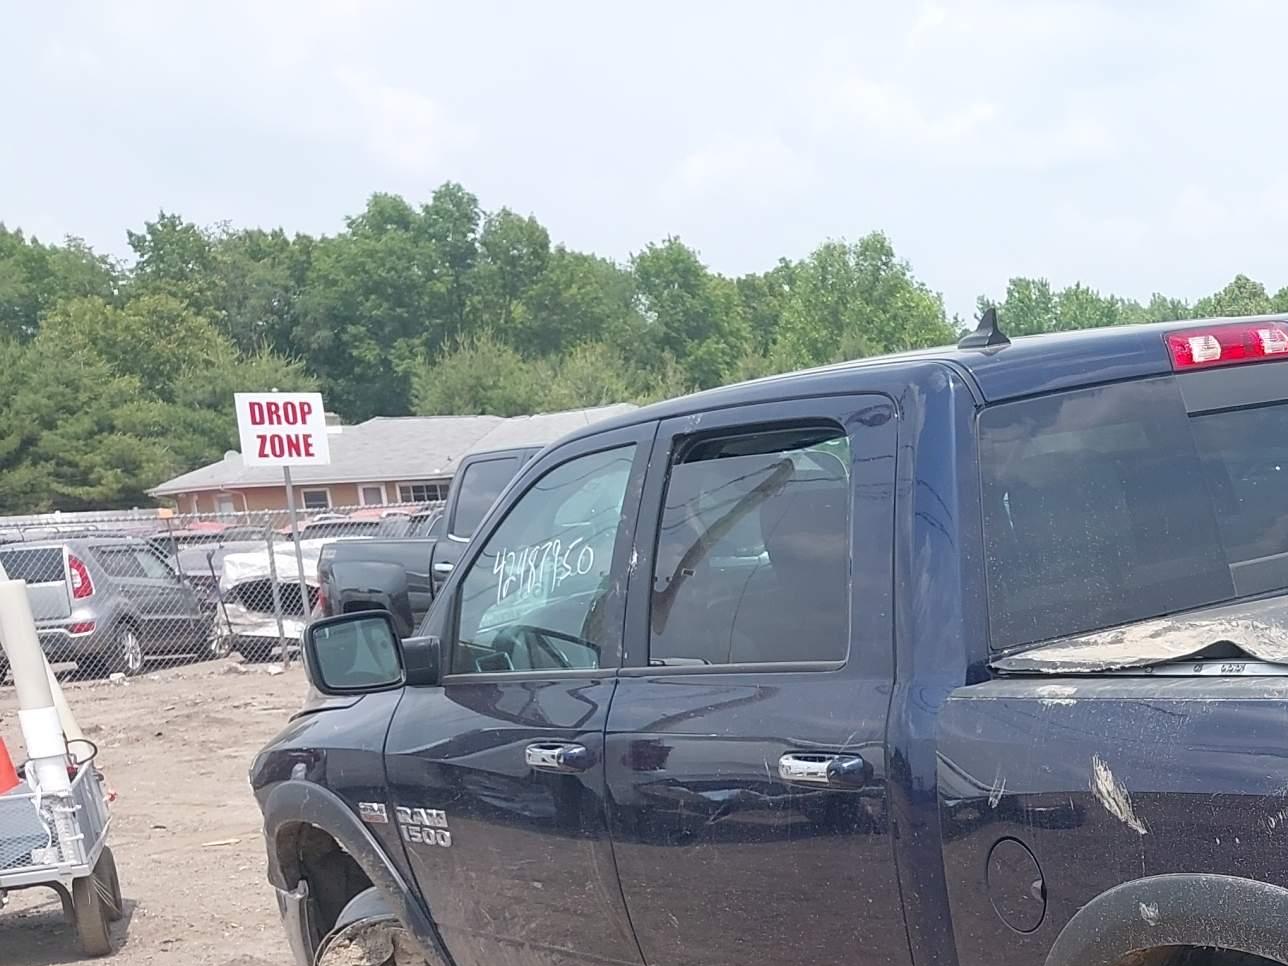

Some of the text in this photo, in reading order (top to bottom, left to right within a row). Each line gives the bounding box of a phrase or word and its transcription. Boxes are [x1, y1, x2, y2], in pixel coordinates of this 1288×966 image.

[248, 401, 313, 426] DROP
[256, 434, 315, 458] ZONE
[493, 537, 594, 605] 42487950
[396, 806, 449, 828] RAM
[400, 825, 452, 848] 1500
